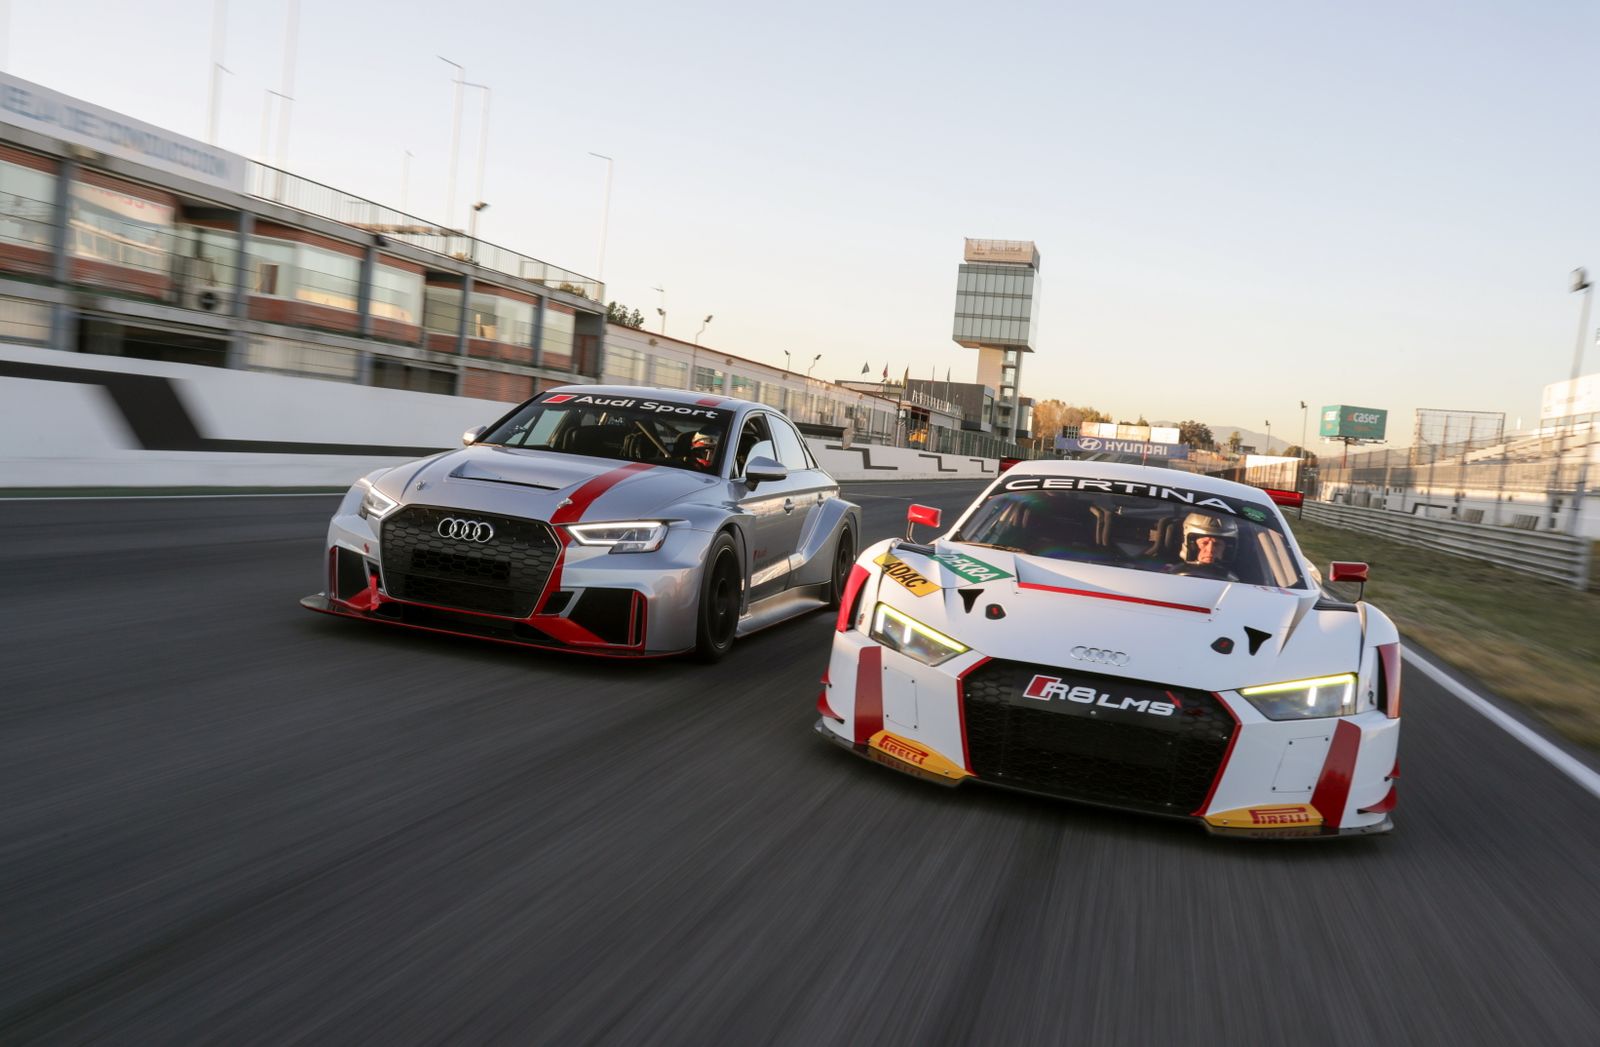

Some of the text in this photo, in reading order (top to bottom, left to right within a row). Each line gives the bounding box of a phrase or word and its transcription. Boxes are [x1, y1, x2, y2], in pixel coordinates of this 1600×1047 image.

[574, 396, 719, 419] Audi Sport
[1353, 412, 1380, 425] caser
[1105, 440, 1168, 456] HYUNDAI
[1005, 478, 1237, 514] CERTINA
[882, 561, 929, 588] ADAC
[939, 554, 1000, 582] DEKRA
[1037, 680, 1175, 717] R8 LMS
[878, 734, 929, 766] PIRELLI
[1248, 807, 1307, 825] PIRELLI
